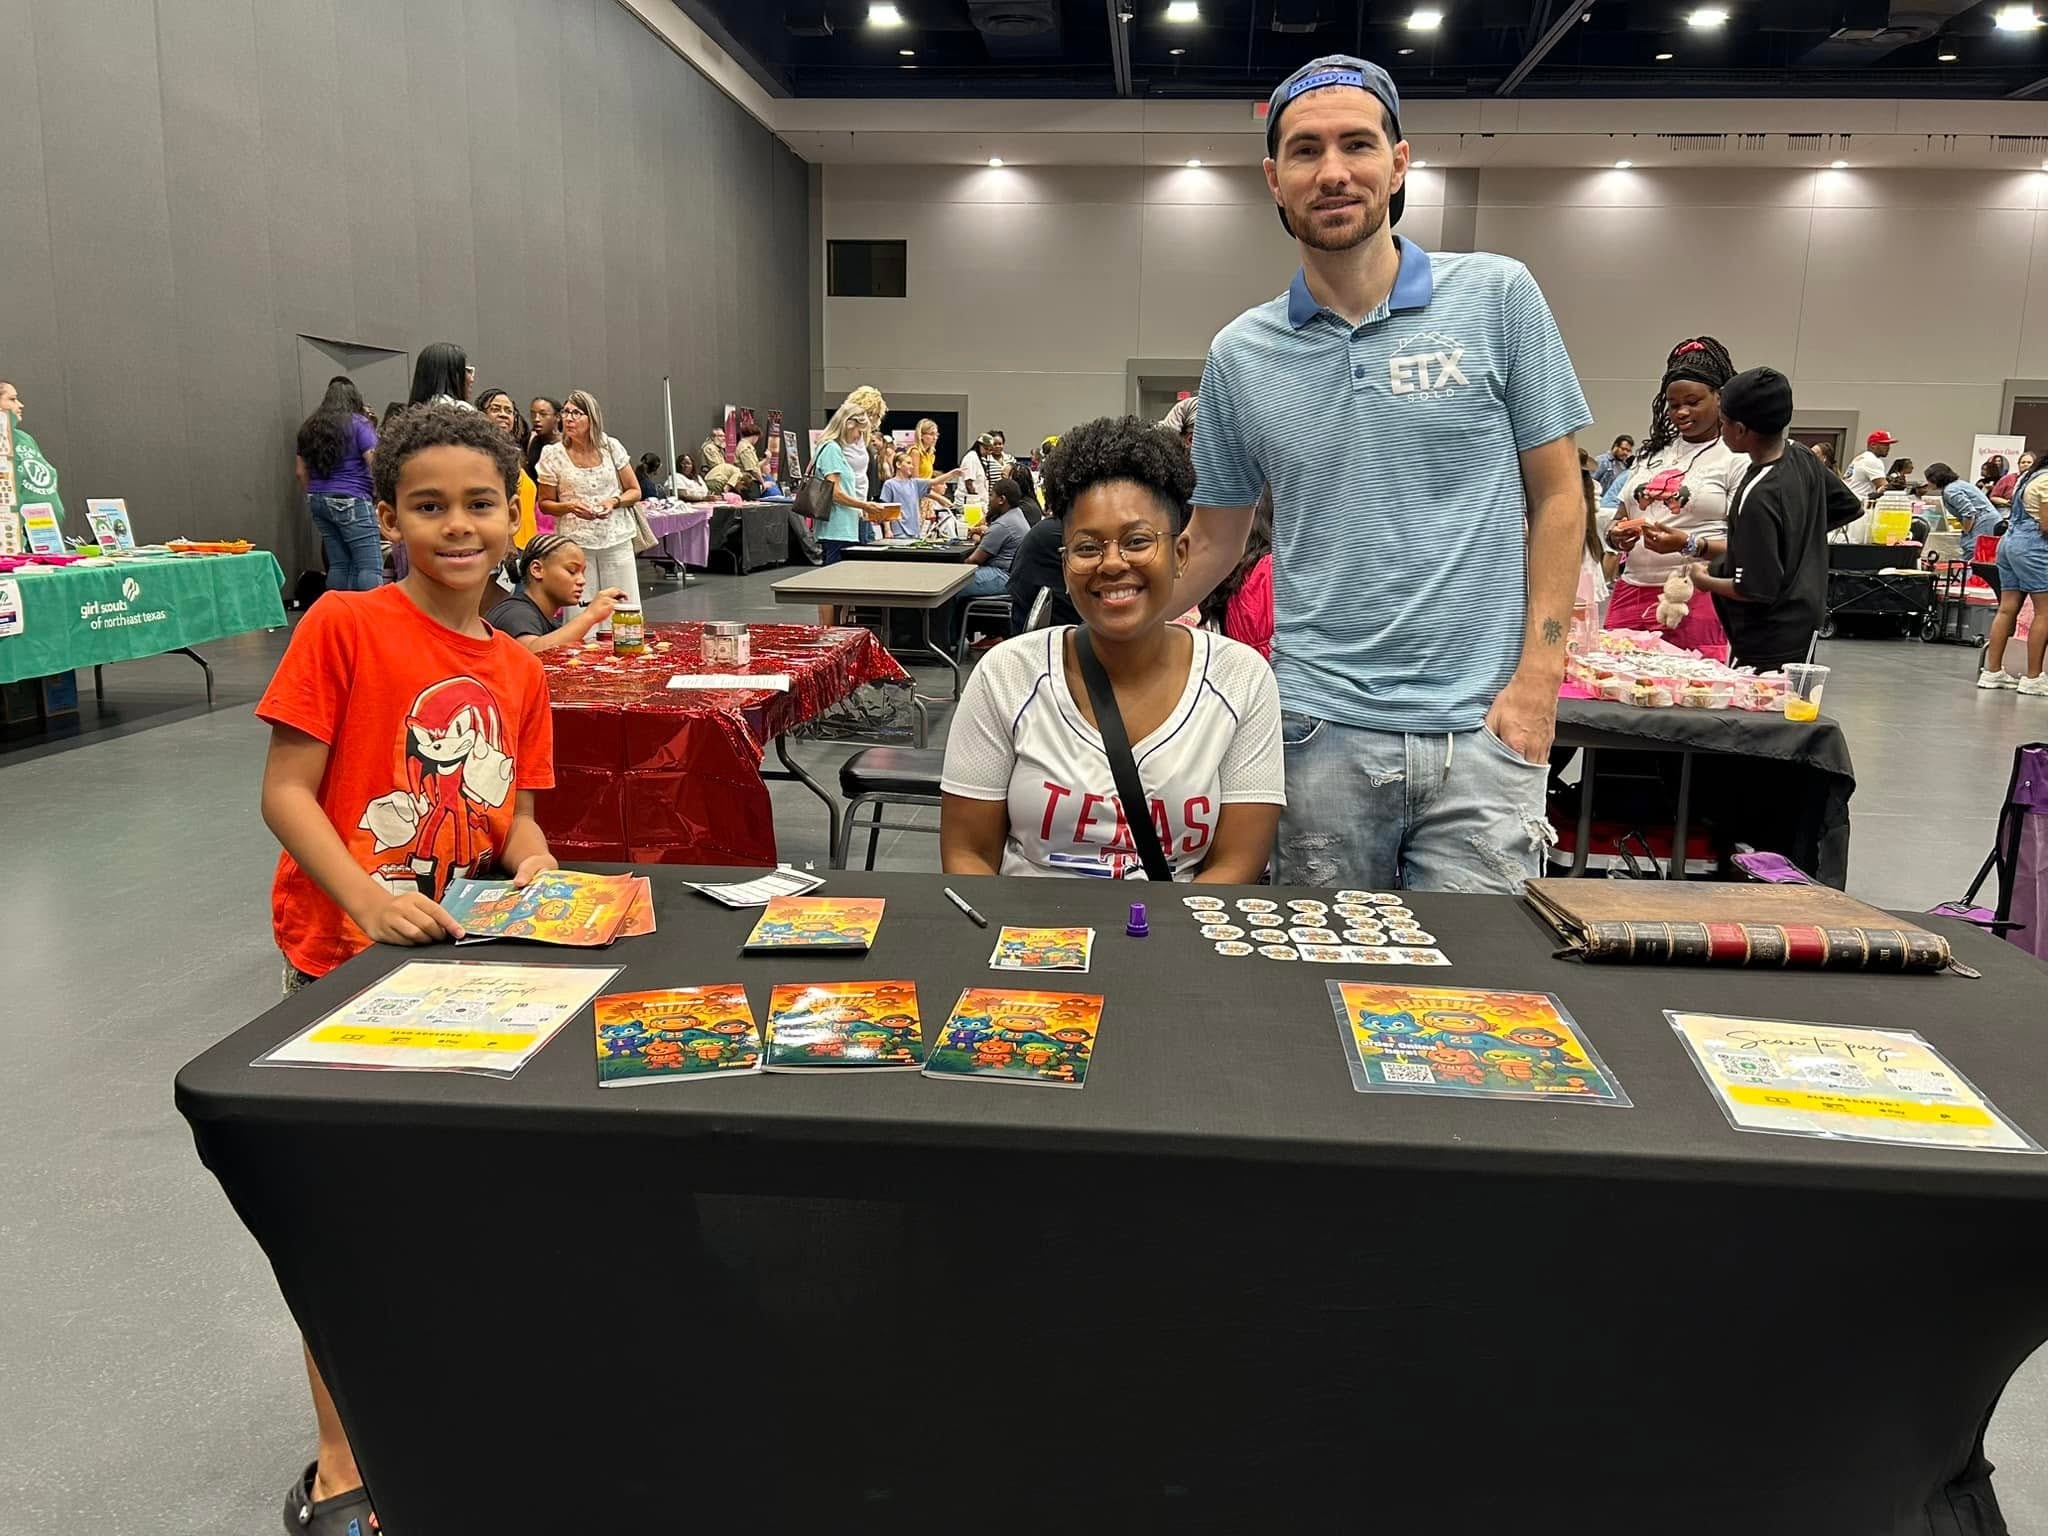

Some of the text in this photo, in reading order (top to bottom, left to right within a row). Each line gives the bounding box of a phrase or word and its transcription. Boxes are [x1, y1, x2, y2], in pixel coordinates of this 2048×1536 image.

[1389, 347, 1470, 395] ETX
[80, 599, 128, 619] girl scouts
[90, 615, 102, 630] of
[142, 610, 167, 623] texas
[1039, 780, 1211, 857] TEXAS
[630, 1003, 722, 1019] BALLHOG
[986, 1004, 1075, 1020] BALLHOG
[1393, 998, 1515, 1016] BALLHOG
[1360, 1039, 1438, 1051] Order Online
[1449, 1035, 1473, 1044] 25
[1384, 1047, 1418, 1056] here!
